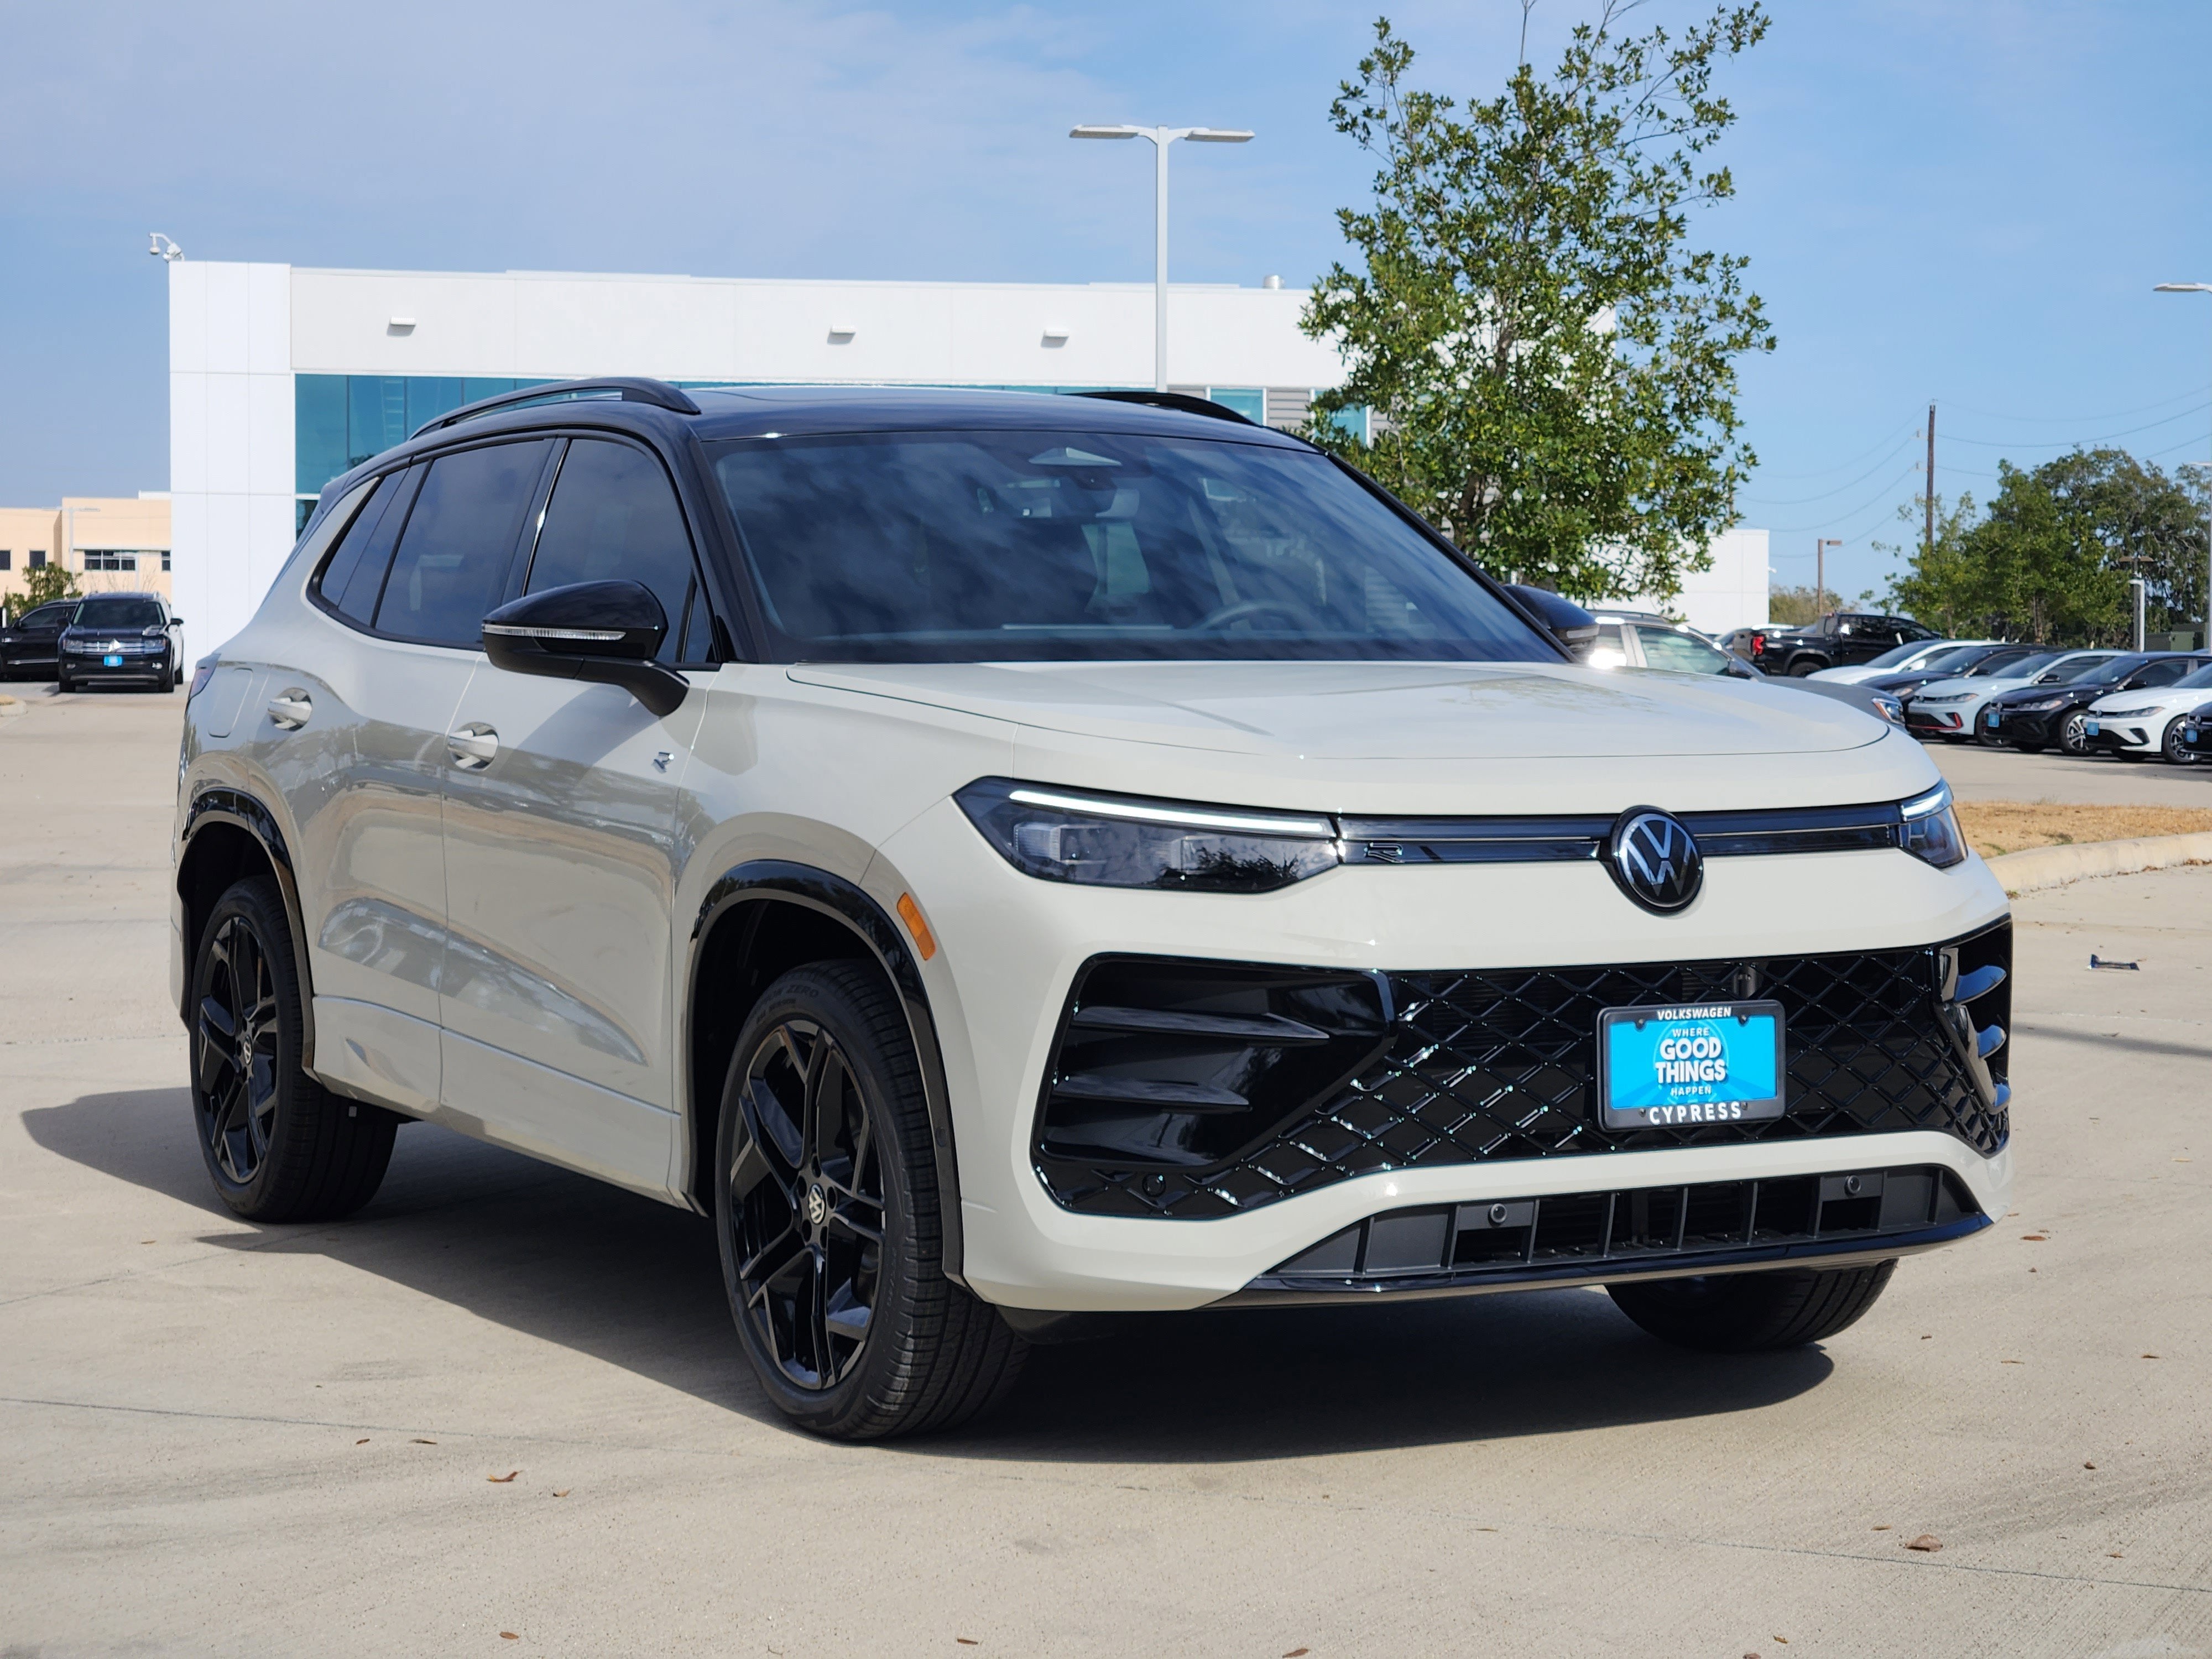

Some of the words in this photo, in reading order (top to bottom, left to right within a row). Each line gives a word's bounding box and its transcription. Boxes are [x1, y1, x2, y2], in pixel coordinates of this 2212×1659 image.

[1620, 813, 1698, 906] VW
[1657, 1006, 1731, 1021] VOLKSWAGEN
[1672, 1027, 1710, 1037] WHERE
[1660, 1037, 1721, 1060] GOOD
[1655, 1059, 1726, 1084] THINGS
[1671, 1085, 1712, 1096] HAPPEN
[1649, 1101, 1741, 1125] CYPRESS
